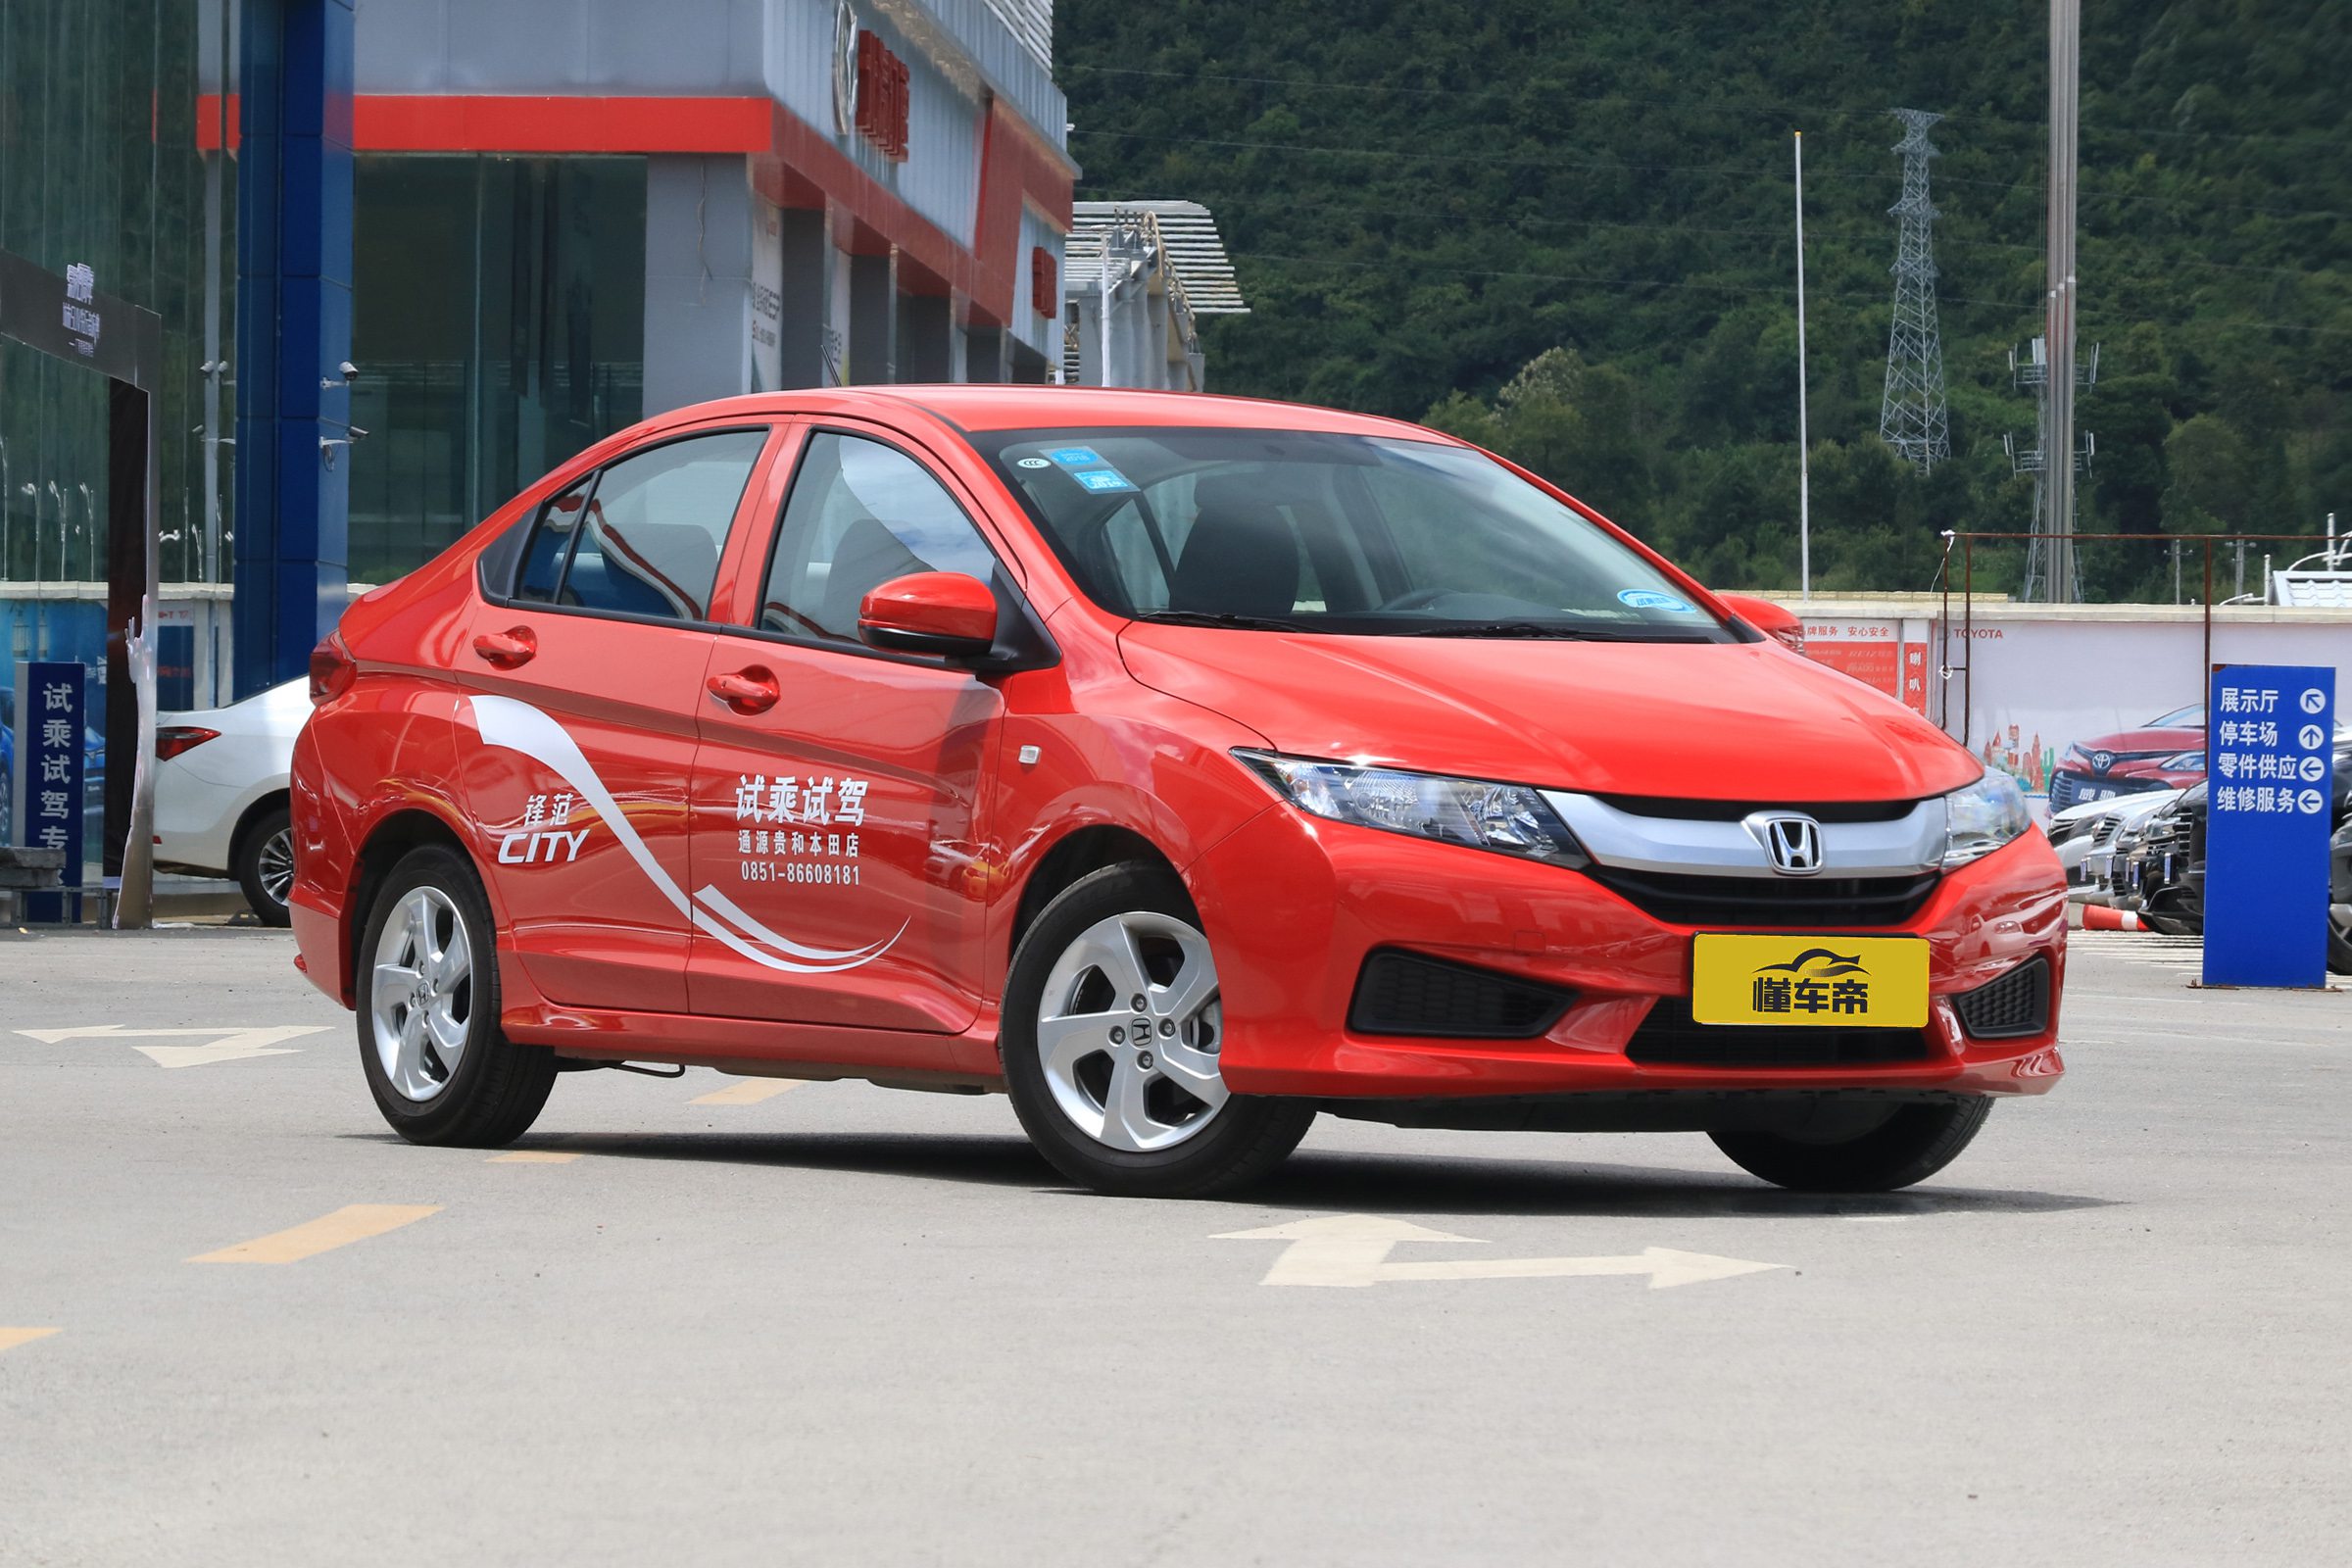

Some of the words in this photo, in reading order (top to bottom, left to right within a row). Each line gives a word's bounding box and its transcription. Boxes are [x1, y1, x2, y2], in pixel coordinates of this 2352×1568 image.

[1804, 625, 1838, 637] 牌服务
[1847, 626, 1889, 637] 安心安全
[1954, 628, 2003, 639] TOYOTA
[2220, 687, 2278, 713] 展示厅
[2219, 720, 2278, 747] 停车场
[2218, 753, 2297, 780] 零件供应
[39, 683, 73, 885] 试乘试驾专
[523, 793, 574, 826] 锋范
[735, 774, 869, 826] 试乘试驾
[2217, 786, 2295, 813] 维修服务
[498, 829, 590, 864] CITY
[738, 830, 859, 858] 通源贵和本田店
[741, 860, 860, 886] 0851-86608181
